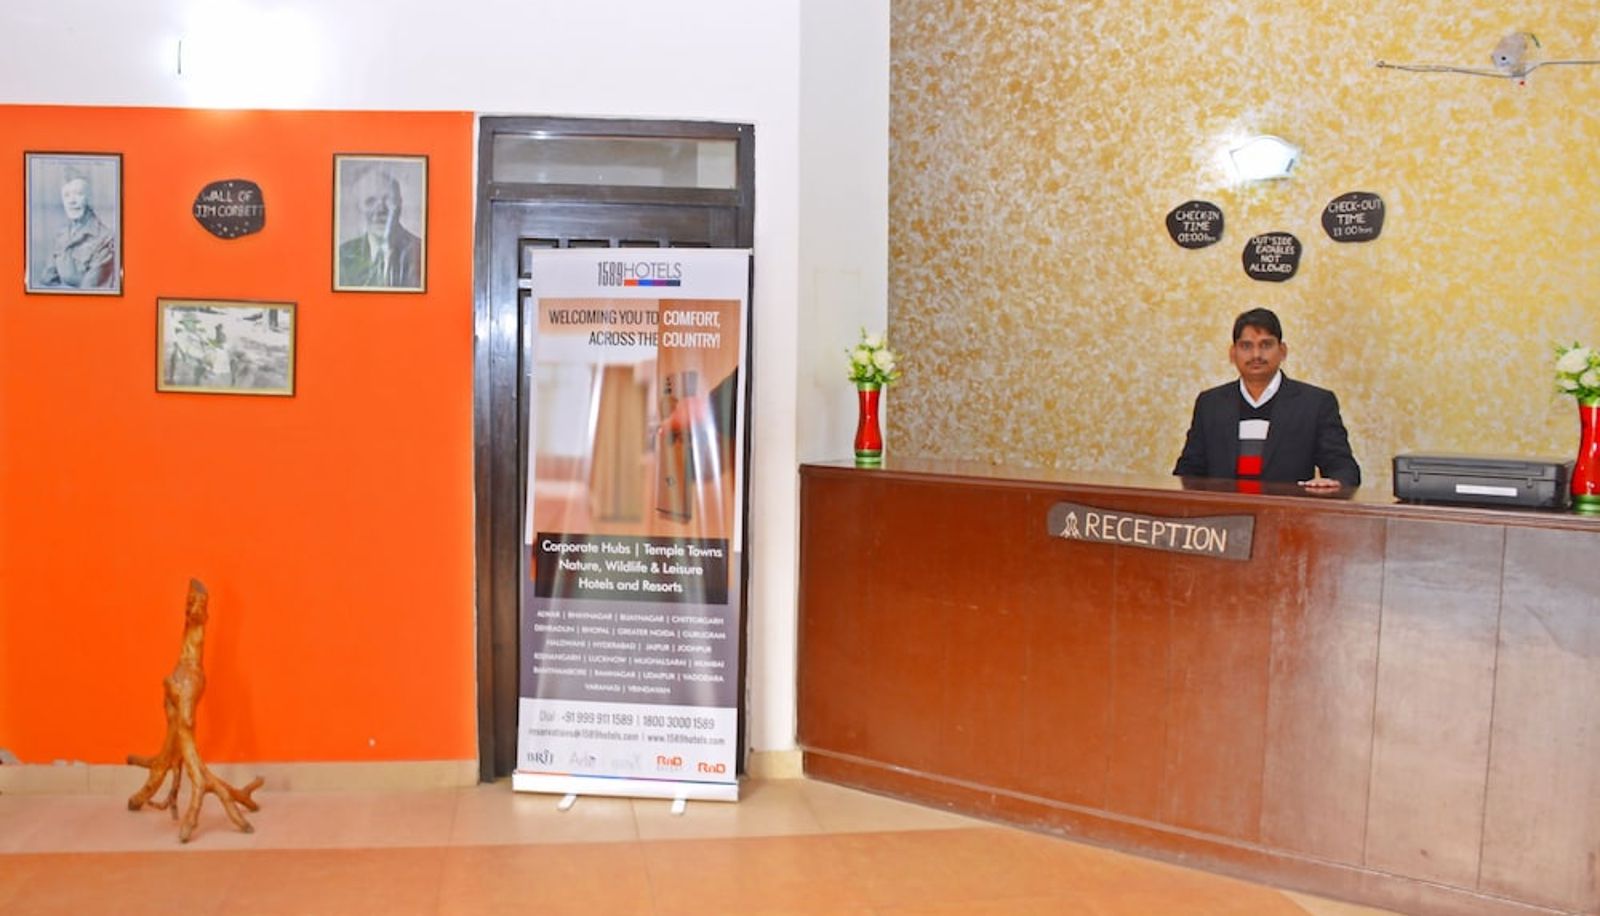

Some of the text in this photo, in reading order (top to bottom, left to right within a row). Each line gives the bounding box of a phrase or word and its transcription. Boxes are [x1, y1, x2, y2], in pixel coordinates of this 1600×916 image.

[202, 189, 254, 203] WALL OF
[1328, 199, 1382, 213] CHECK-OUT
[1336, 213, 1367, 225] TIME
[1183, 221, 1211, 232] TIME
[1260, 254, 1282, 263] NOT
[1249, 263, 1293, 273] ALLOWED
[549, 309, 721, 328] WELCOMING YOU TO COMFORT,
[588, 332, 721, 349] ACROSS THE COUNTRY!
[1085, 512, 1227, 552] RECEPTION
[542, 540, 723, 558] Corporate Hubs Temple Towns
[558, 559, 704, 576] Nature, Wildlife & Leisure
[578, 578, 683, 593] Hotels and Resorts
[581, 625, 609, 635] BHOPAL
[617, 627, 648, 636] GREATER
[649, 629, 675, 638] NOIDA
[587, 654, 627, 664] LUCKNOW
[576, 711, 595, 724] 999
[596, 712, 610, 725] 911
[611, 713, 634, 726] 1589
[643, 715, 665, 728] 1800
[667, 716, 692, 729] 3000
[693, 717, 716, 730] 1589
